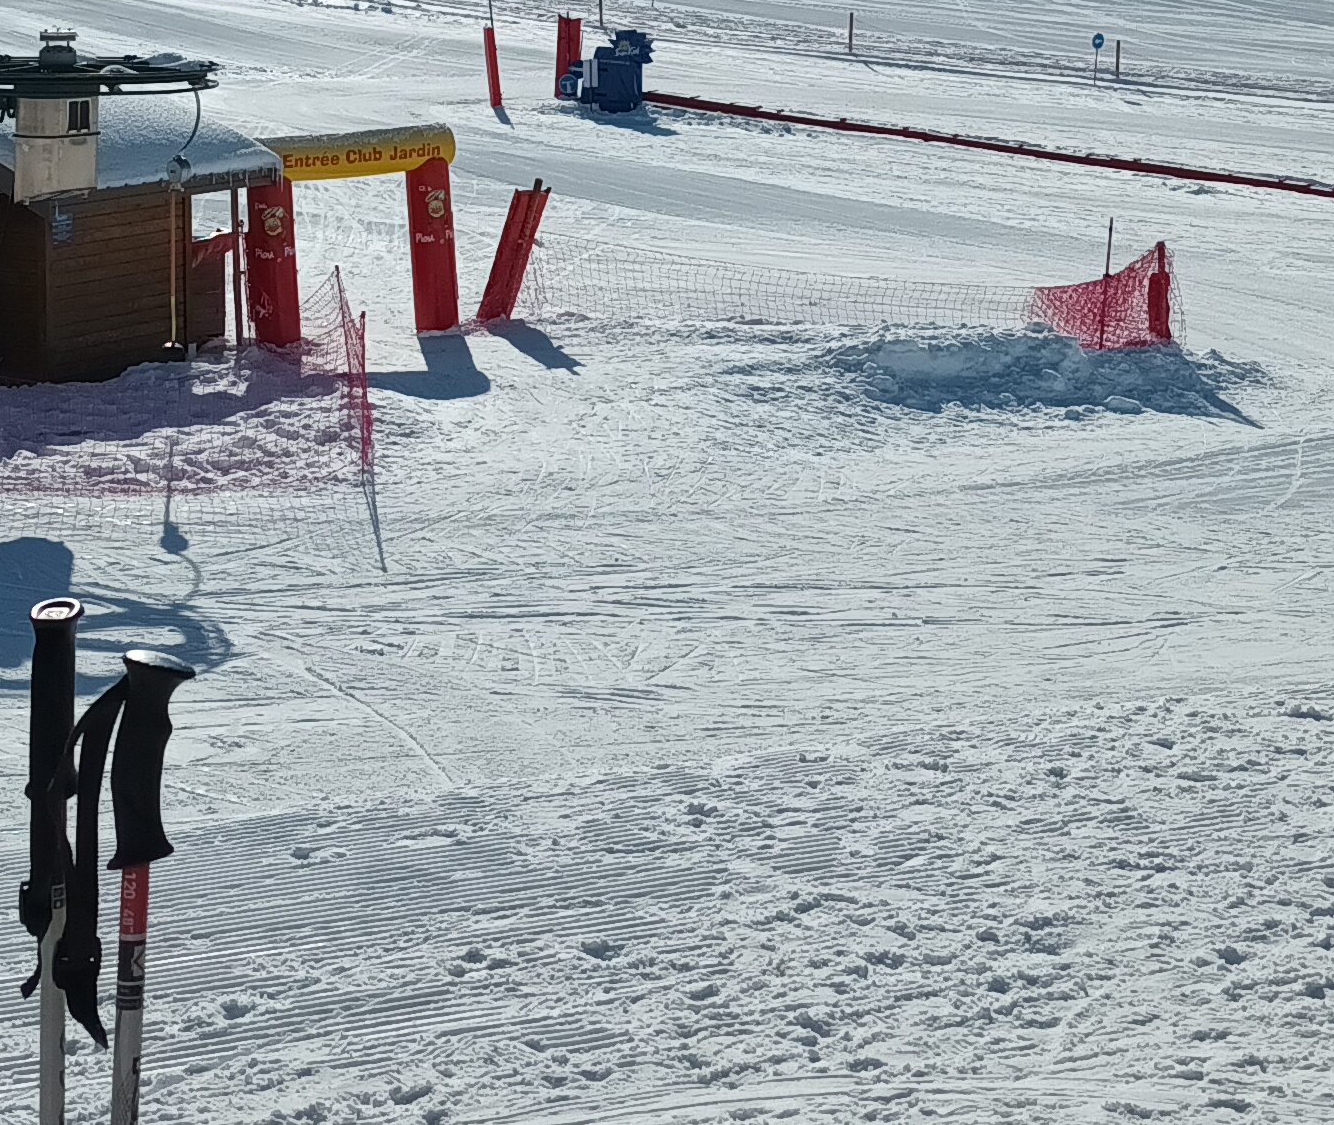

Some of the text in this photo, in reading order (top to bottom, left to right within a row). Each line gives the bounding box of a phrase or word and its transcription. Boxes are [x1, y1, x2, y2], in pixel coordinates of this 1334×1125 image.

[283, 143, 441, 169] Entrée Club Jardin
[123, 872, 137, 900] 120
